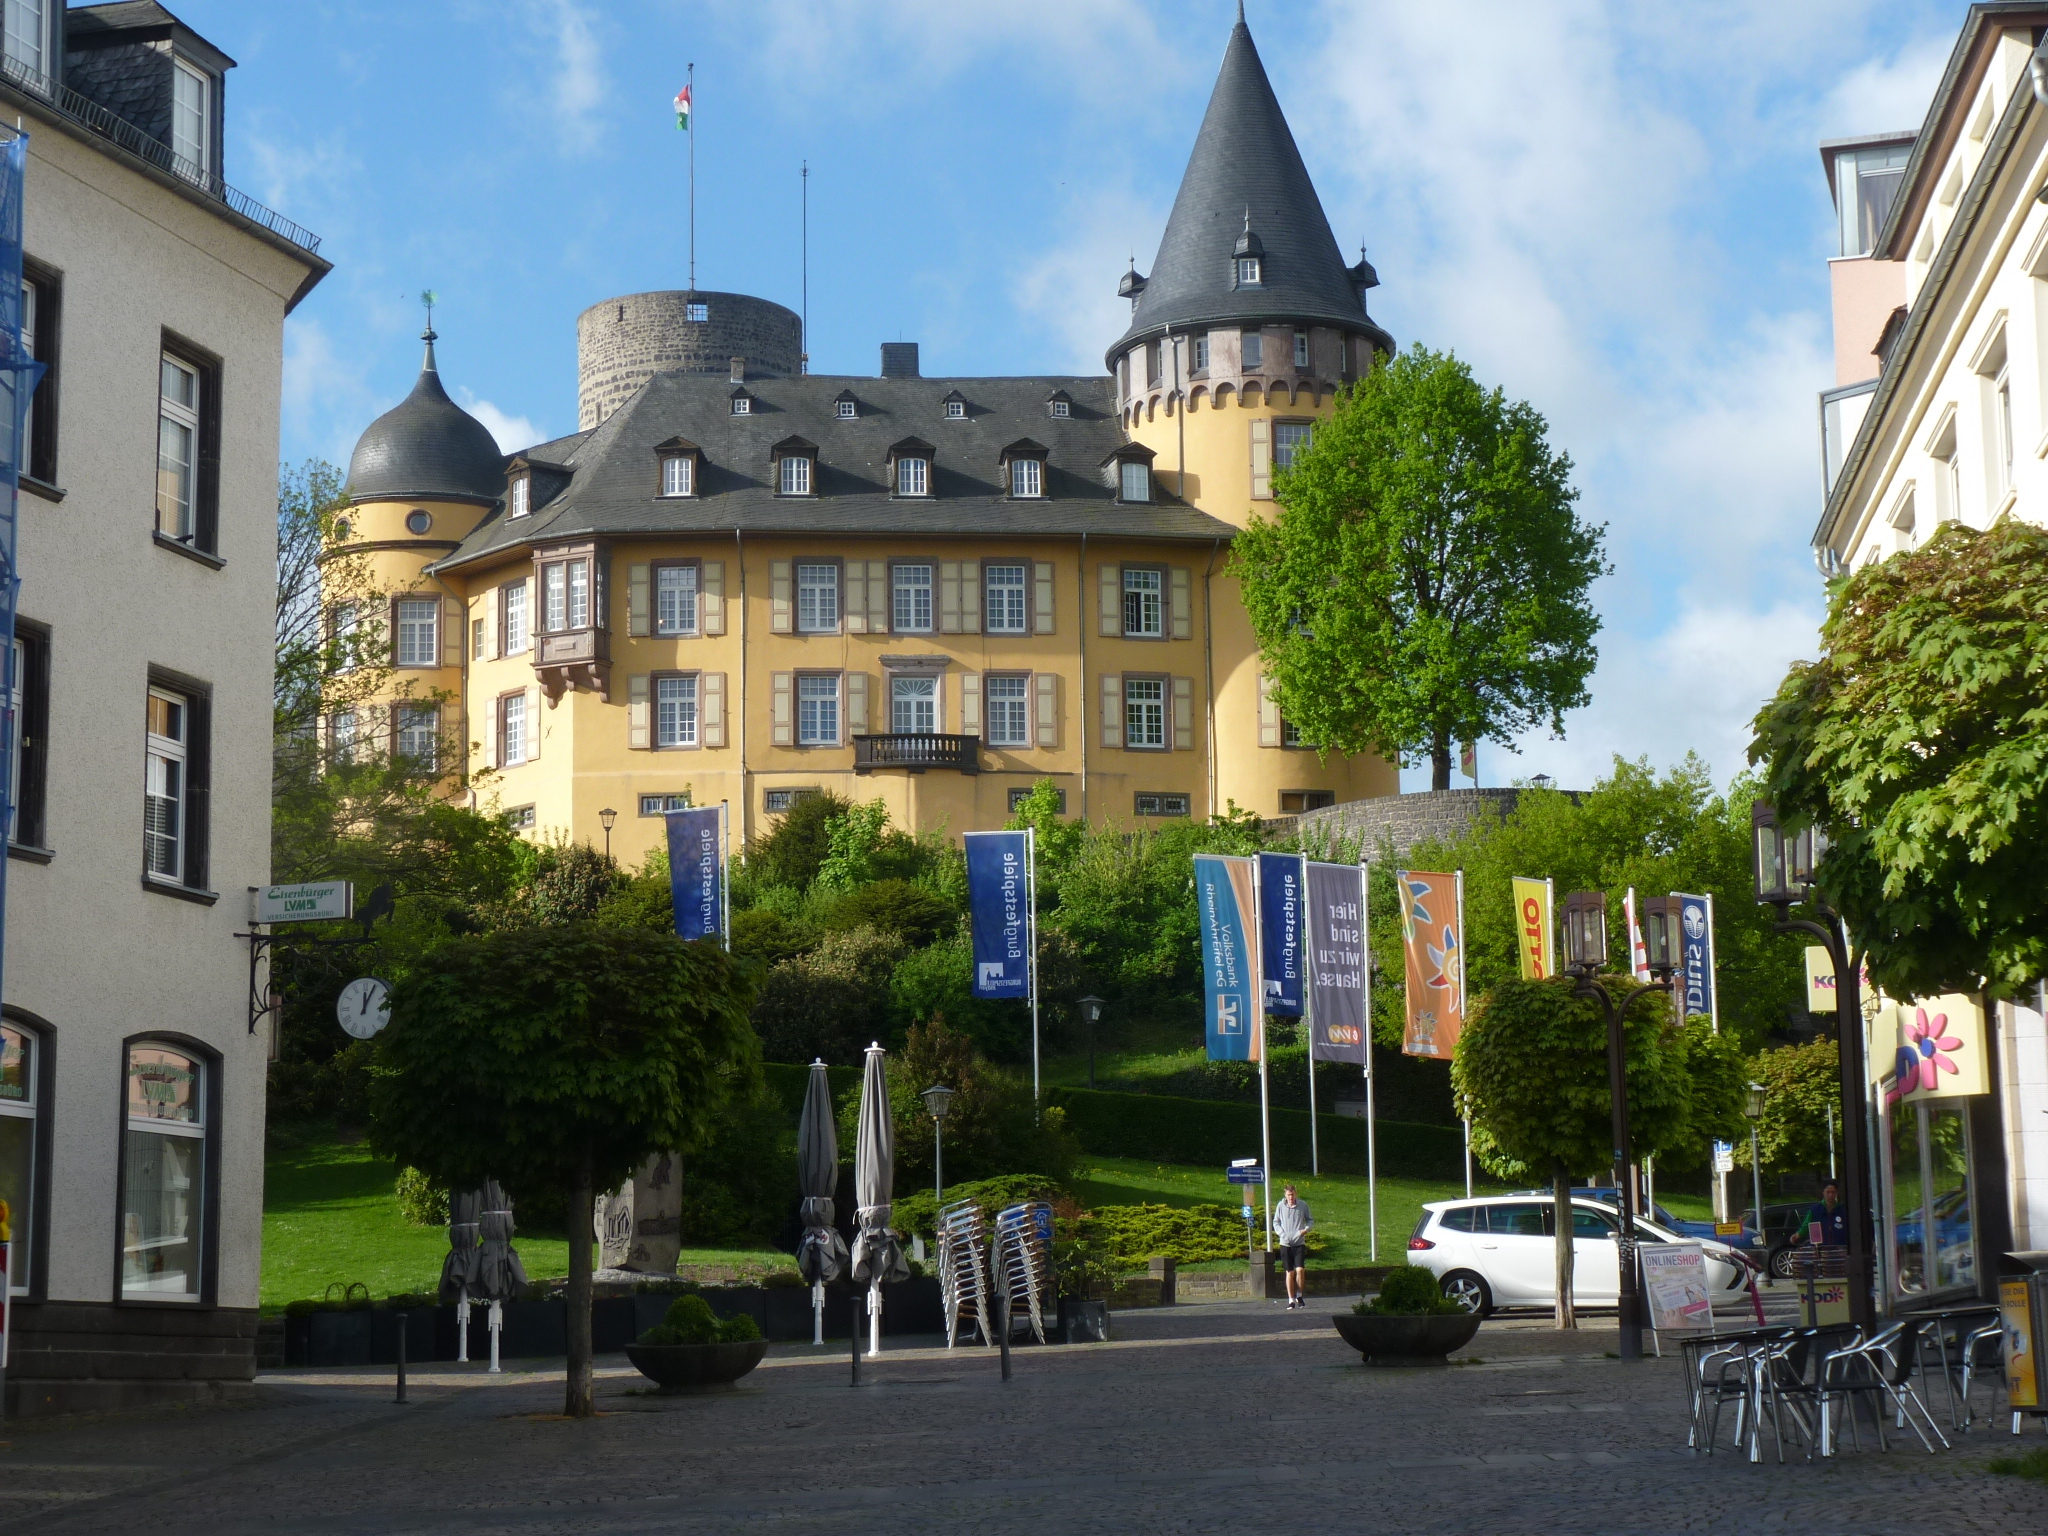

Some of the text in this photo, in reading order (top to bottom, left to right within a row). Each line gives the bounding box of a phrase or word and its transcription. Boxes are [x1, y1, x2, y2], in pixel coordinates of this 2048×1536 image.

[267, 886, 335, 900] Eisenbürger
[284, 899, 306, 912] LVM
[267, 910, 334, 920] VERSICHERUNGSBÜRO
[1205, 883, 1227, 988] RheinAhrEifel eG
[1221, 924, 1239, 988] Volksbank
[1645, 1254, 1700, 1267] ONLINESHOP
